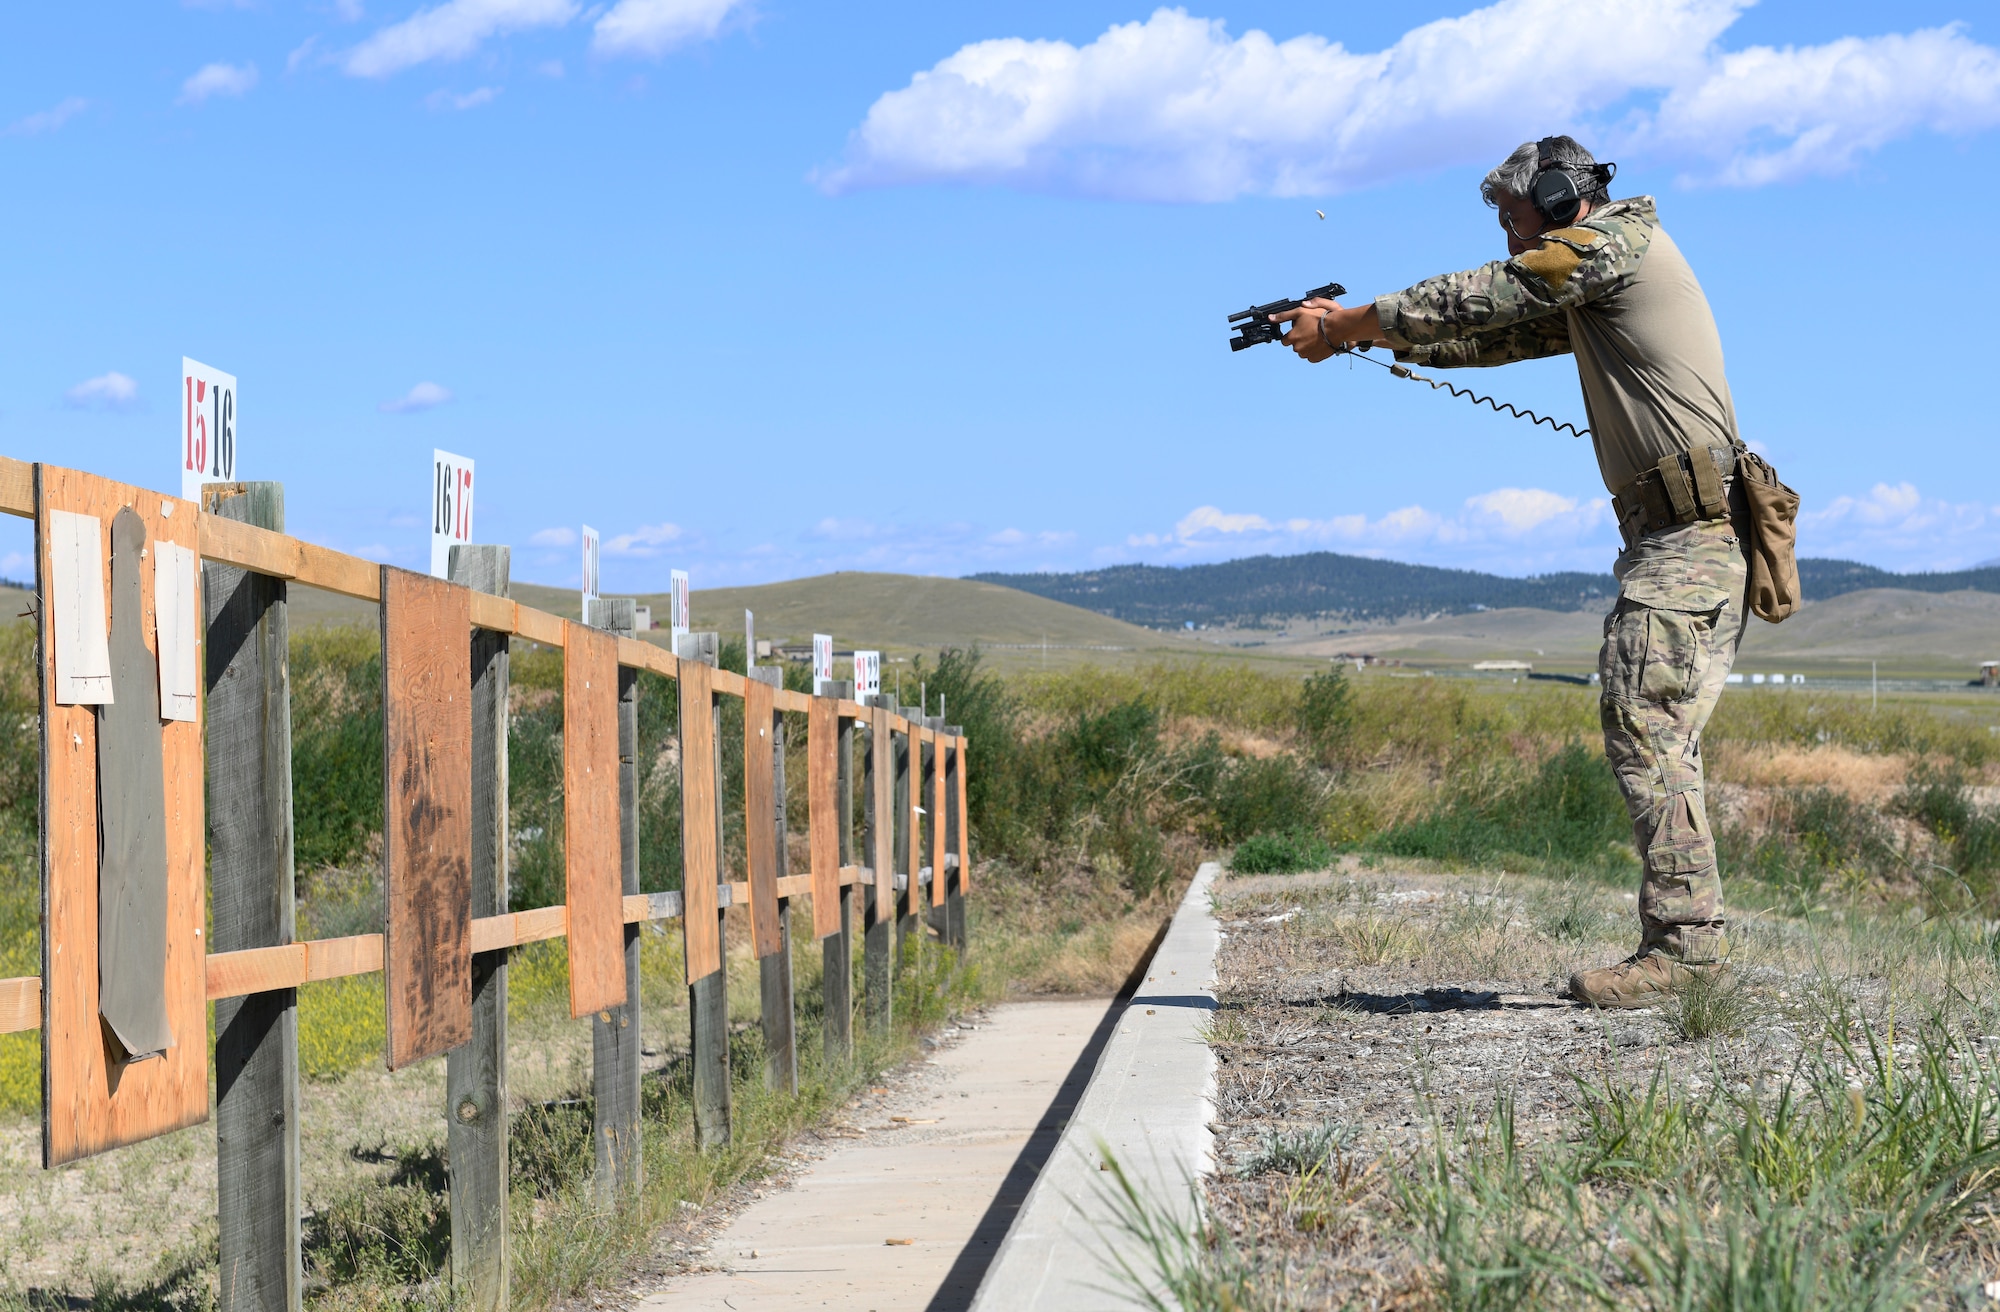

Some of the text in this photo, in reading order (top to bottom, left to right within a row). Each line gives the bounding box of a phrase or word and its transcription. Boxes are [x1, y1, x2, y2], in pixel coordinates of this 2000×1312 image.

[186, 376, 232, 481] 15 16
[435, 462, 471, 542] 16 17
[673, 577, 680, 627] 18
[857, 656, 877, 691] 21 22
